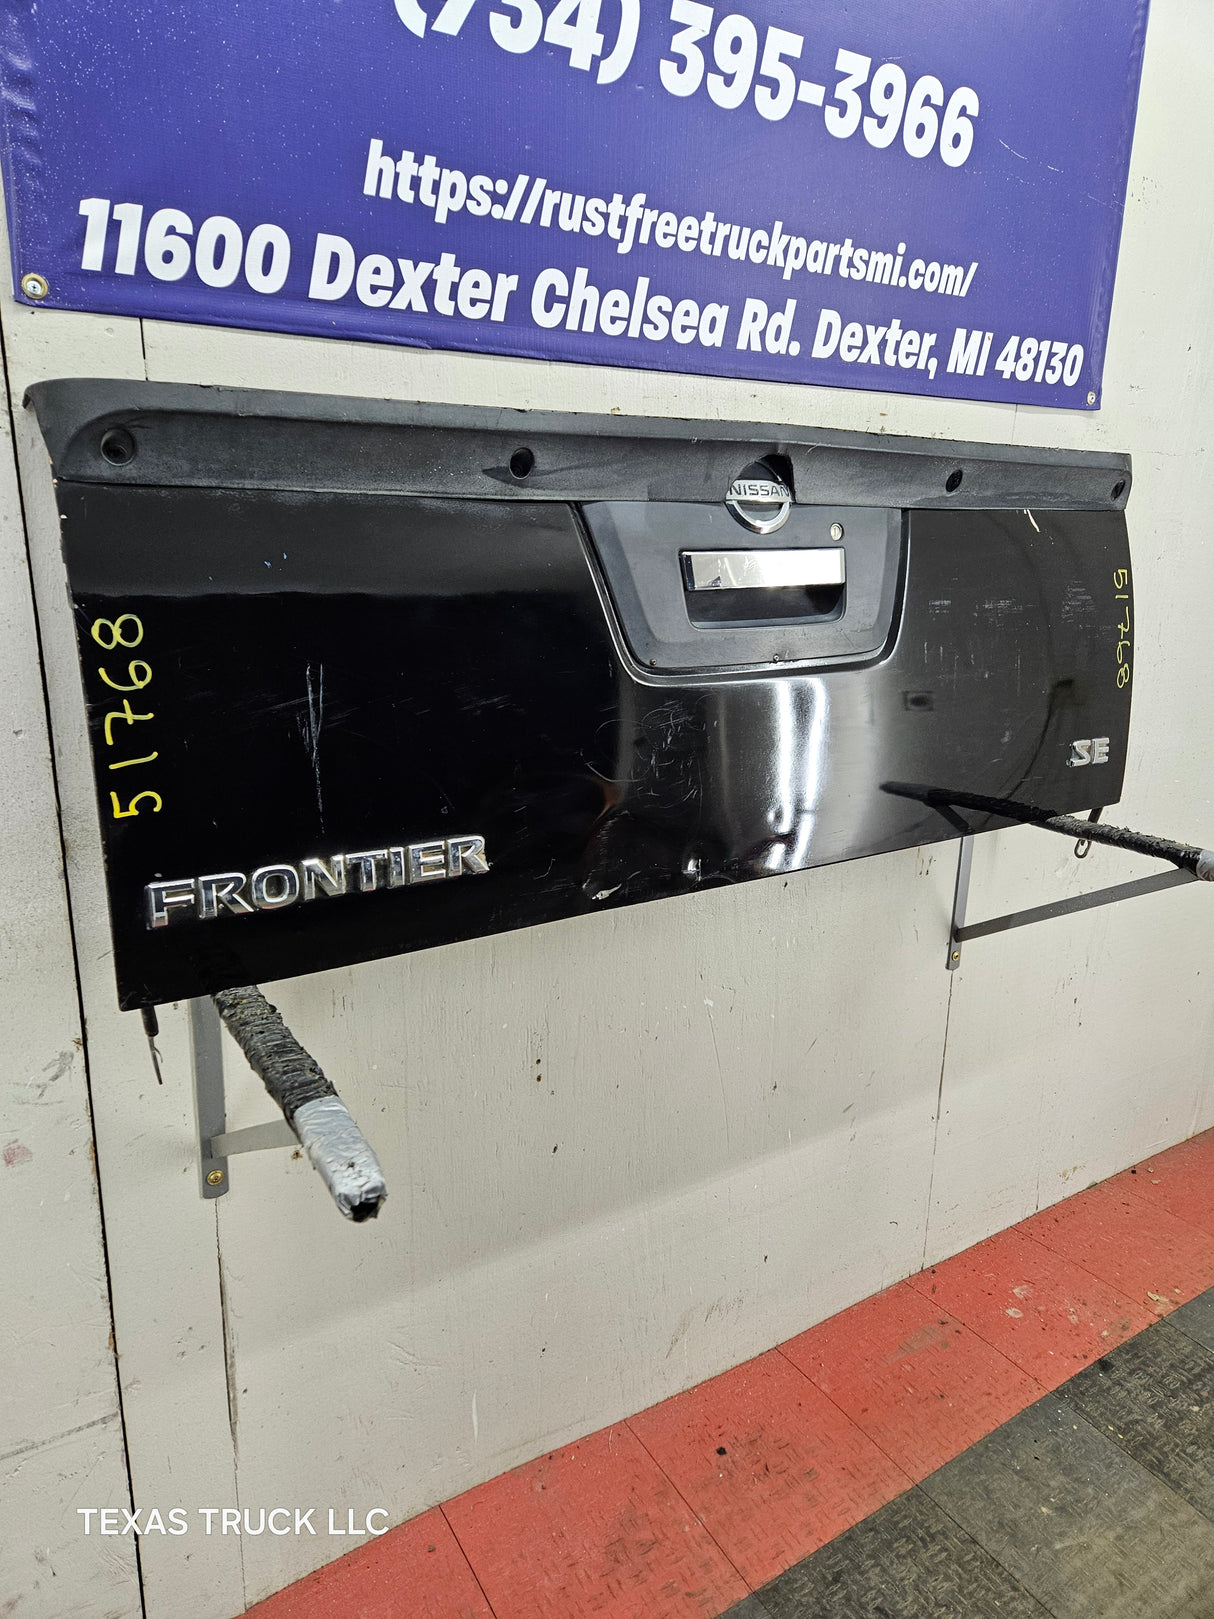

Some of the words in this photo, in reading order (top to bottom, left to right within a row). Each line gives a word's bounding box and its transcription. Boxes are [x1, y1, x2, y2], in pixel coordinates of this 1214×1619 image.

[660, 0, 980, 168] 395-3966
[362, 138, 980, 298] https://rustfreetruckpartsmi.com/
[78, 197, 291, 294] 11600
[307, 232, 520, 323] Dexter
[530, 267, 730, 348] Chelsea
[735, 297, 801, 357] Rd.
[810, 308, 938, 380] Dexter,
[945, 327, 994, 377] MI
[994, 335, 1084, 387] 48130
[729, 484, 792, 497] NISSAN
[1113, 568, 1131, 689] 51768
[91, 613, 162, 819] 51768
[1065, 736, 1110, 768] SE
[145, 835, 490, 931] FRONTIER
